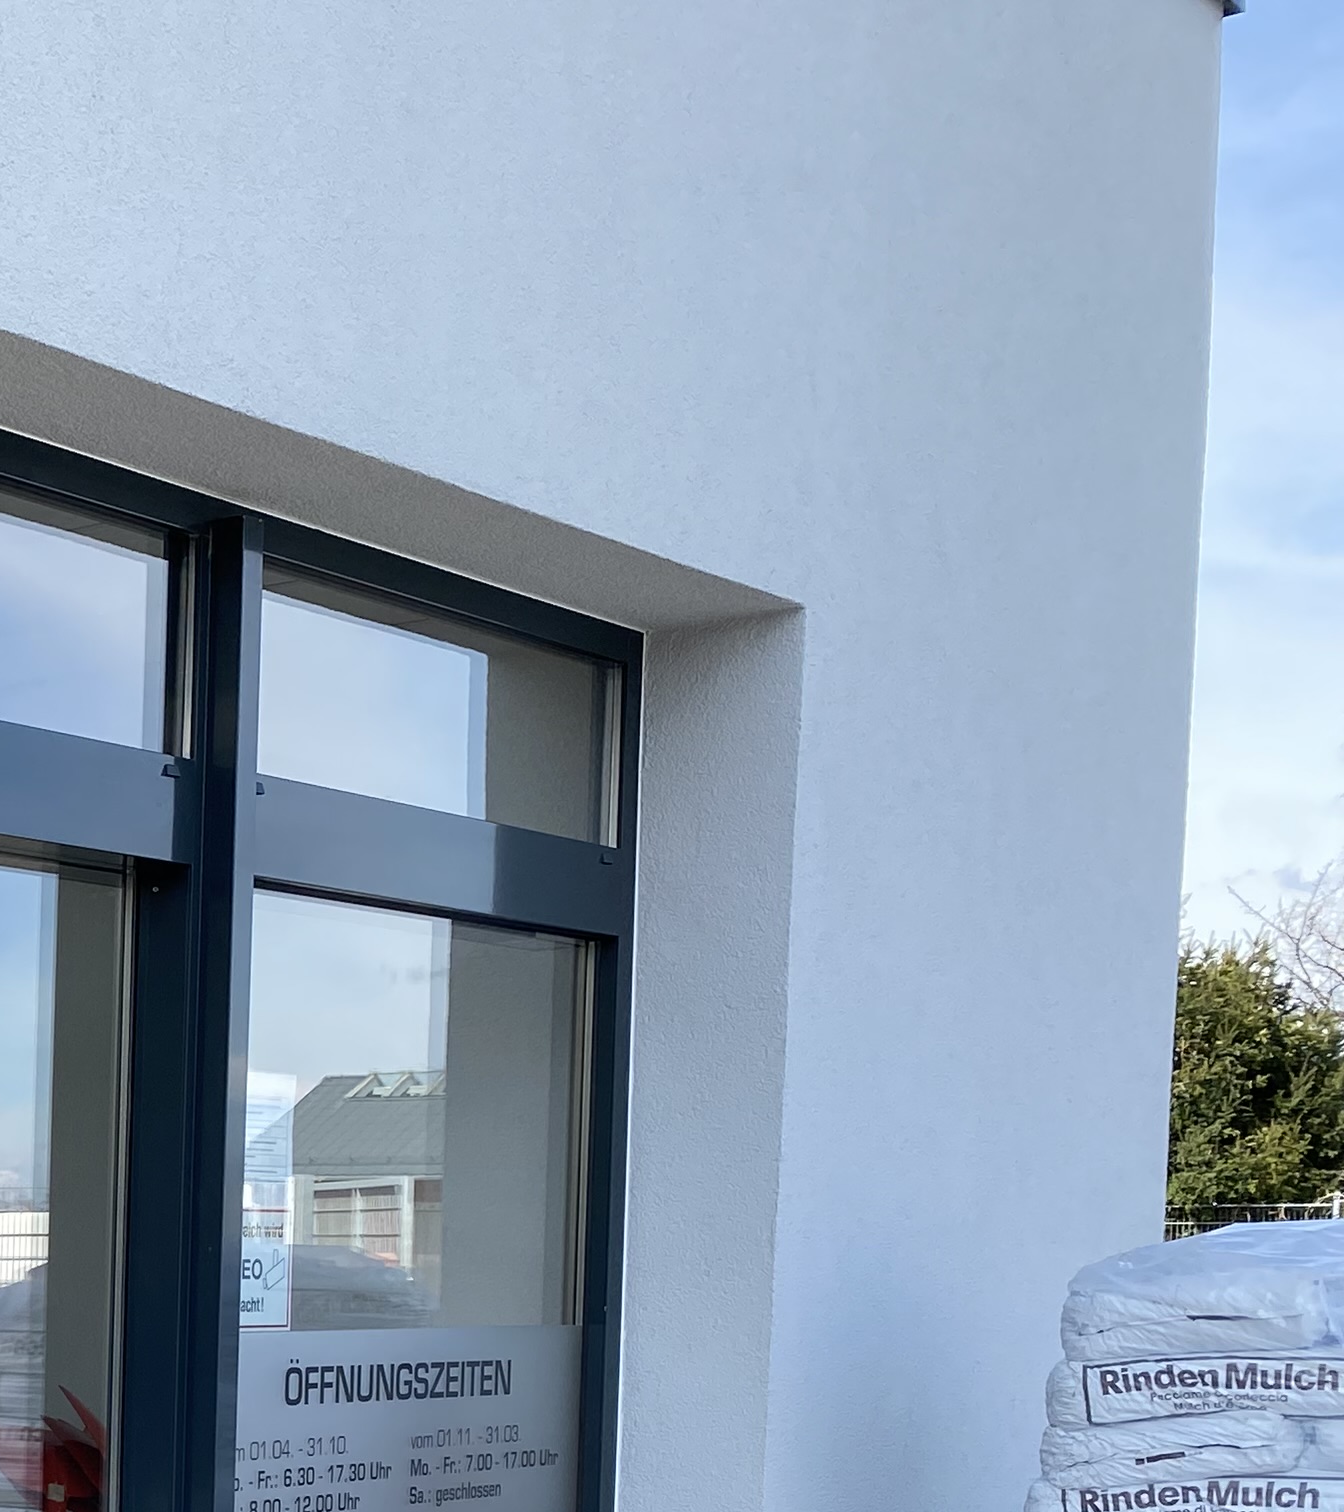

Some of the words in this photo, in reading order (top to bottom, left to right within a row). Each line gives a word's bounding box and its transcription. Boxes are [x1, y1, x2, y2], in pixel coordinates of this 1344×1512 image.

[284, 1358, 512, 1406] ÖFFNUNGSZEITEN
[250, 1440, 294, 1462] 01.04.
[307, 1436, 348, 1457] 31.10.
[410, 1434, 433, 1449] vom
[437, 1428, 475, 1448] 01.11.
[486, 1424, 521, 1444] 31.03.
[257, 1471, 278, 1490] Fr.:
[284, 1467, 315, 1488] 6.30
[328, 1462, 366, 1483] 17.30
[370, 1461, 392, 1480] Uhr
[410, 1458, 432, 1477] Mo.
[443, 1457, 461, 1474] Fr.:
[466, 1453, 492, 1472] 7.00
[503, 1450, 536, 1469] 17.00
[539, 1449, 558, 1466] Uhr
[338, 1492, 360, 1511] Uhr
[410, 1487, 432, 1504] Sa.:
[436, 1482, 501, 1507] geschlossen
